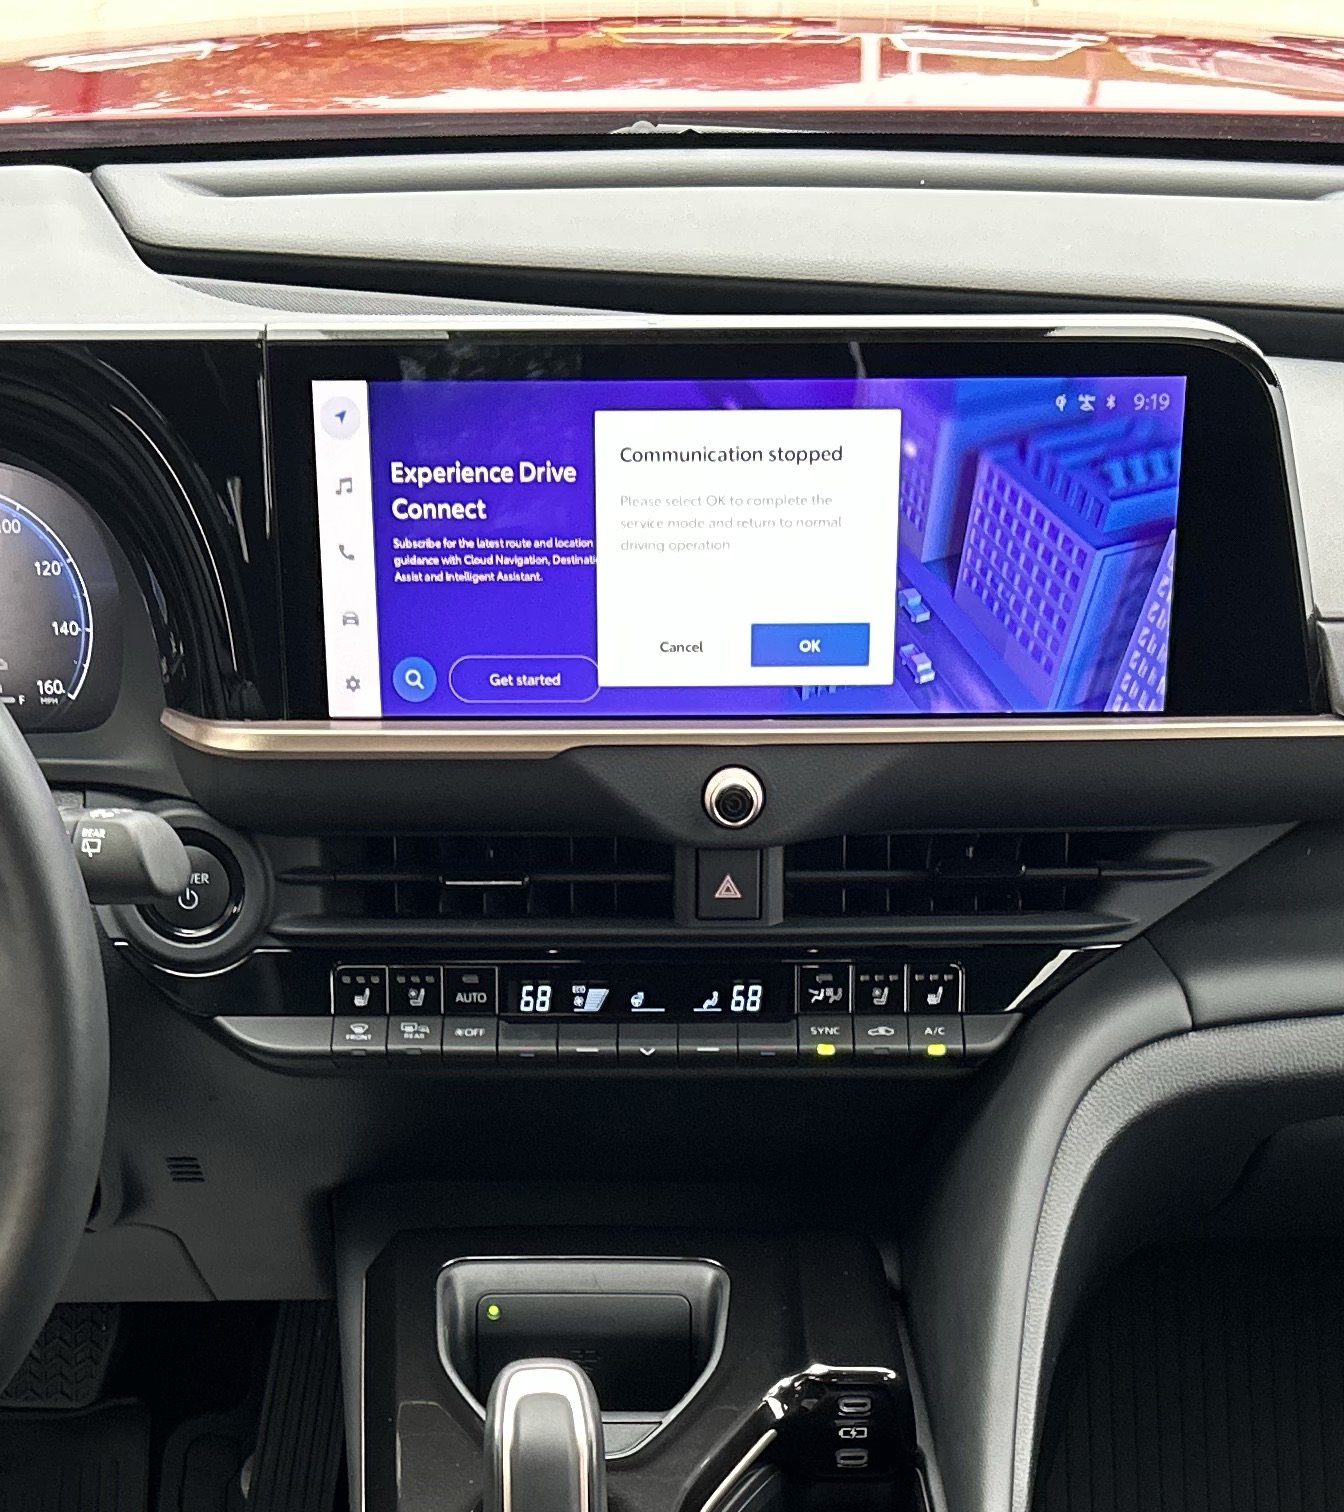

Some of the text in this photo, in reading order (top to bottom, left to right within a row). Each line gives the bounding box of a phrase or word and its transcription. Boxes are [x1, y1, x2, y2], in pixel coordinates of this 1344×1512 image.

[1133, 393, 1171, 411] 9:19
[620, 445, 843, 468] Communication stopped
[391, 460, 577, 488] Experience Drive
[391, 497, 488, 521] Connect
[620, 494, 833, 511] Please select OK to complete the
[620, 516, 842, 530] service mode and return to normal
[392, 537, 594, 550] Subscribe for the latest route and location
[620, 538, 731, 555] driving operation
[394, 554, 440, 567] guidance
[441, 554, 462, 566] with
[463, 554, 493, 566] Cloud
[495, 554, 551, 567] Navigation,
[34, 561, 62, 577] 120
[394, 571, 544, 586] Assist and Intelligent Assistant.
[52, 621, 79, 637] 140
[660, 639, 821, 655] Cancel OK
[36, 679, 64, 695] 160
[489, 672, 561, 687] Get started
[18, 694, 26, 705] F
[40, 697, 59, 705] MPH
[81, 827, 106, 838] REAR
[455, 992, 487, 1003] AUTO
[519, 985, 552, 1012] 68
[730, 985, 763, 1012] 68
[345, 1033, 372, 1041] FRONT
[464, 1027, 486, 1037] OFF
[810, 1026, 841, 1036] SYNC
[924, 1026, 946, 1036] A/C
